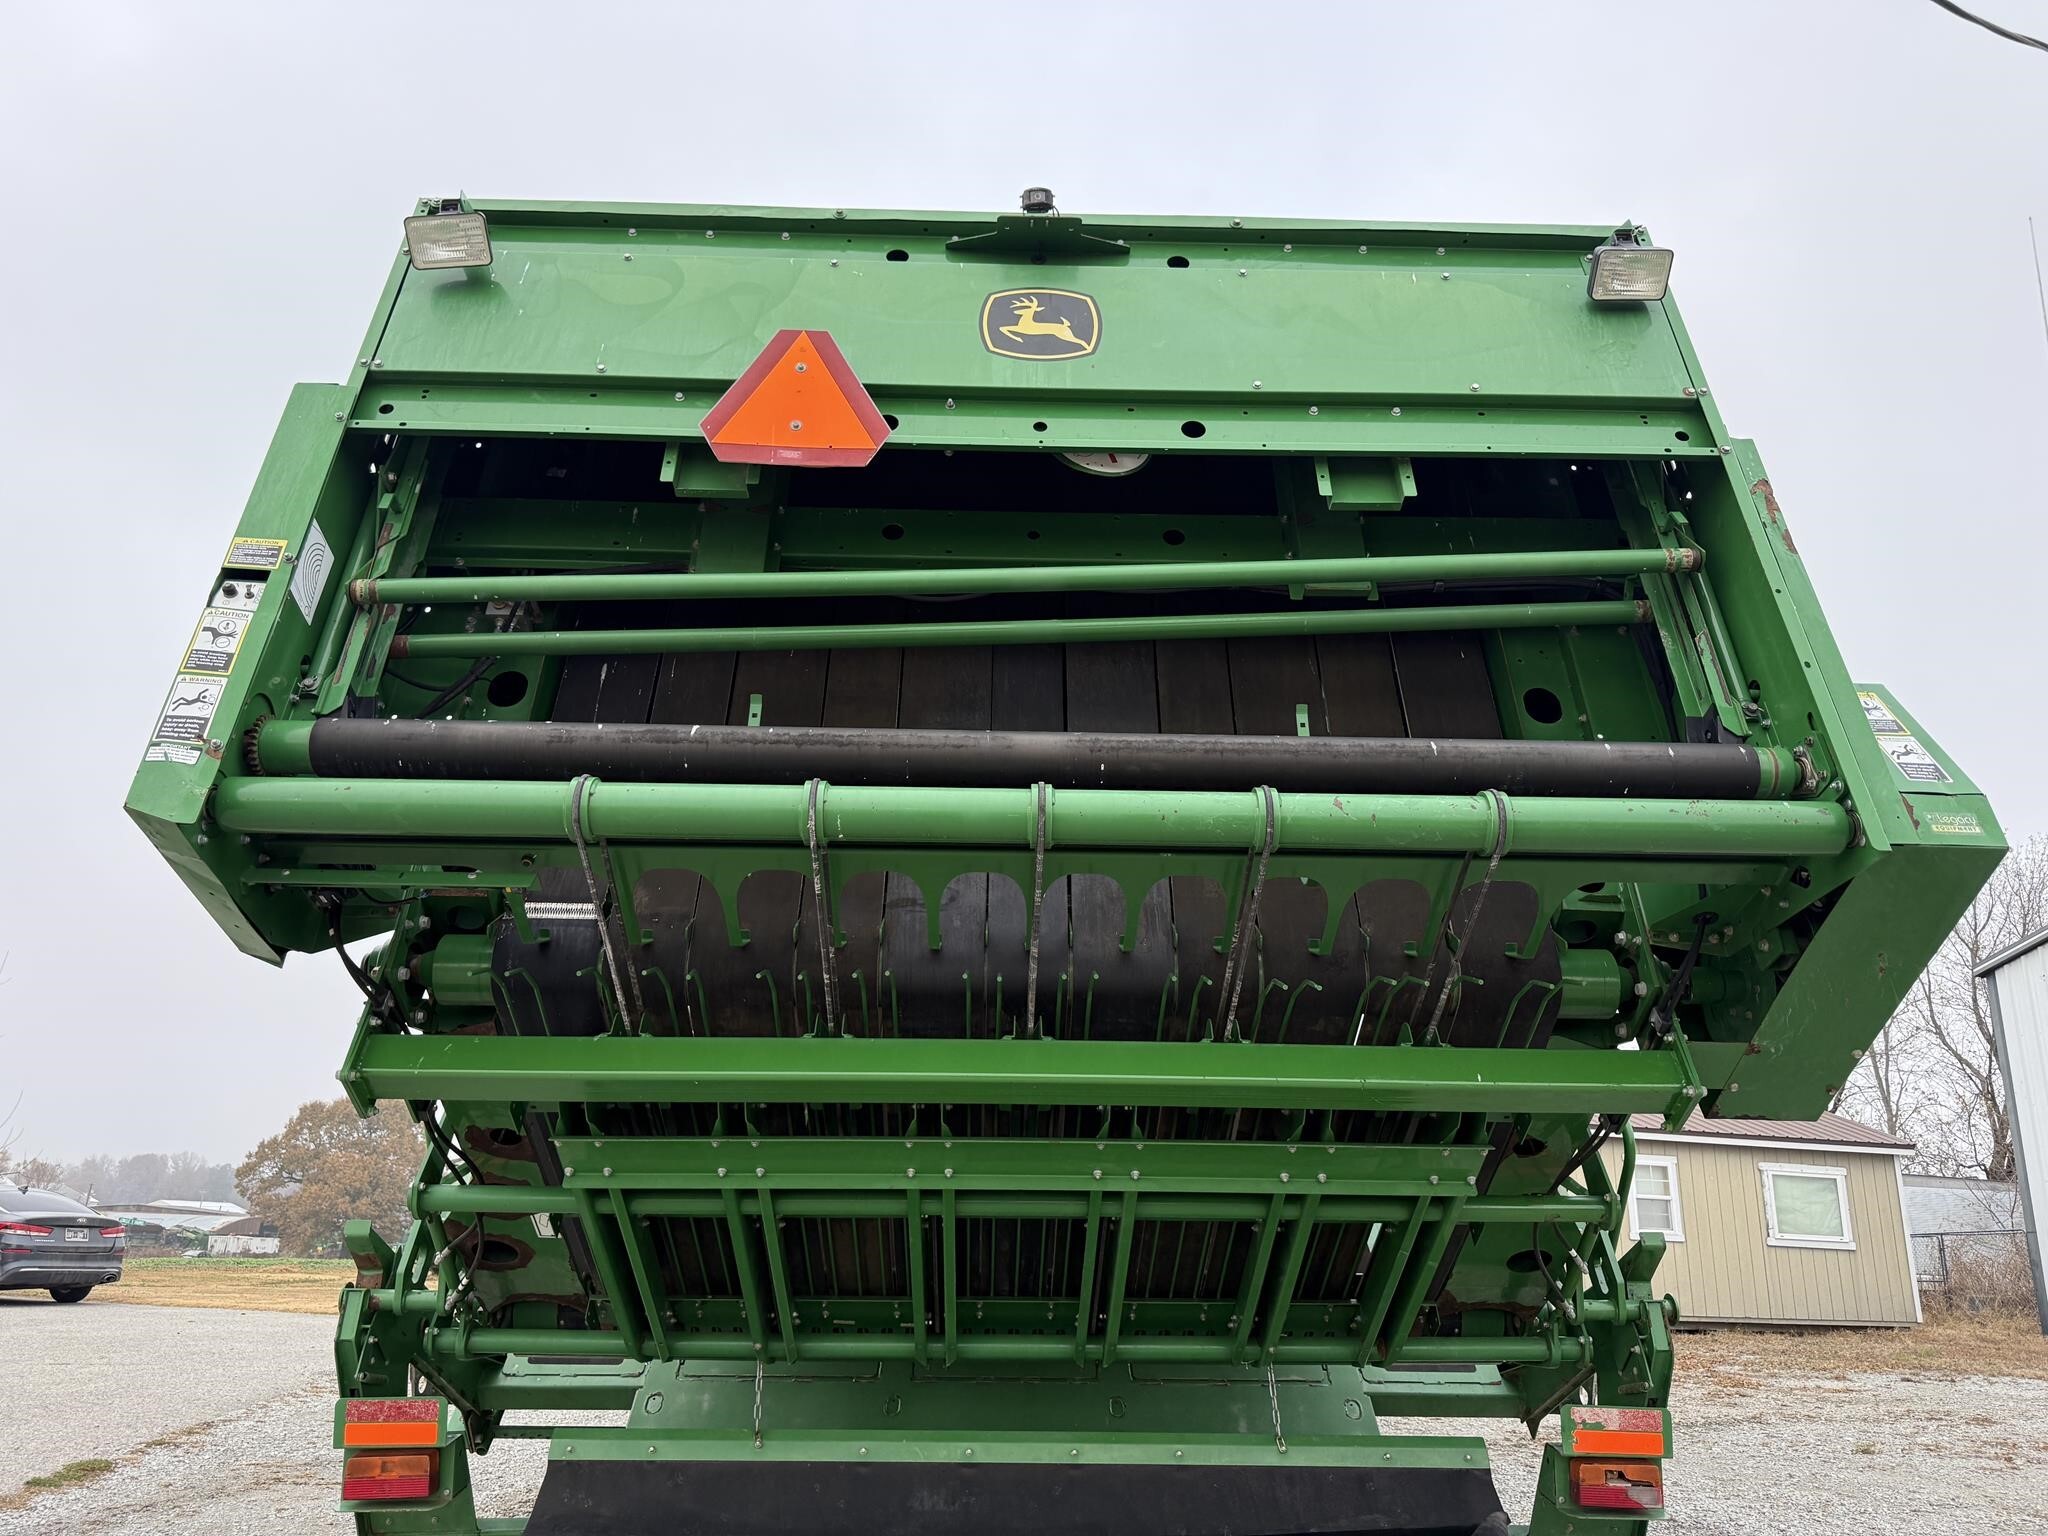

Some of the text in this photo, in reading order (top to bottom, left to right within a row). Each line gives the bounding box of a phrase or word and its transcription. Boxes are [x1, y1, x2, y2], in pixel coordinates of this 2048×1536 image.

[214, 610, 249, 618] CAUTION
[160, 743, 191, 751] IMPORTANT
[1936, 813, 1976, 826] Legacy
